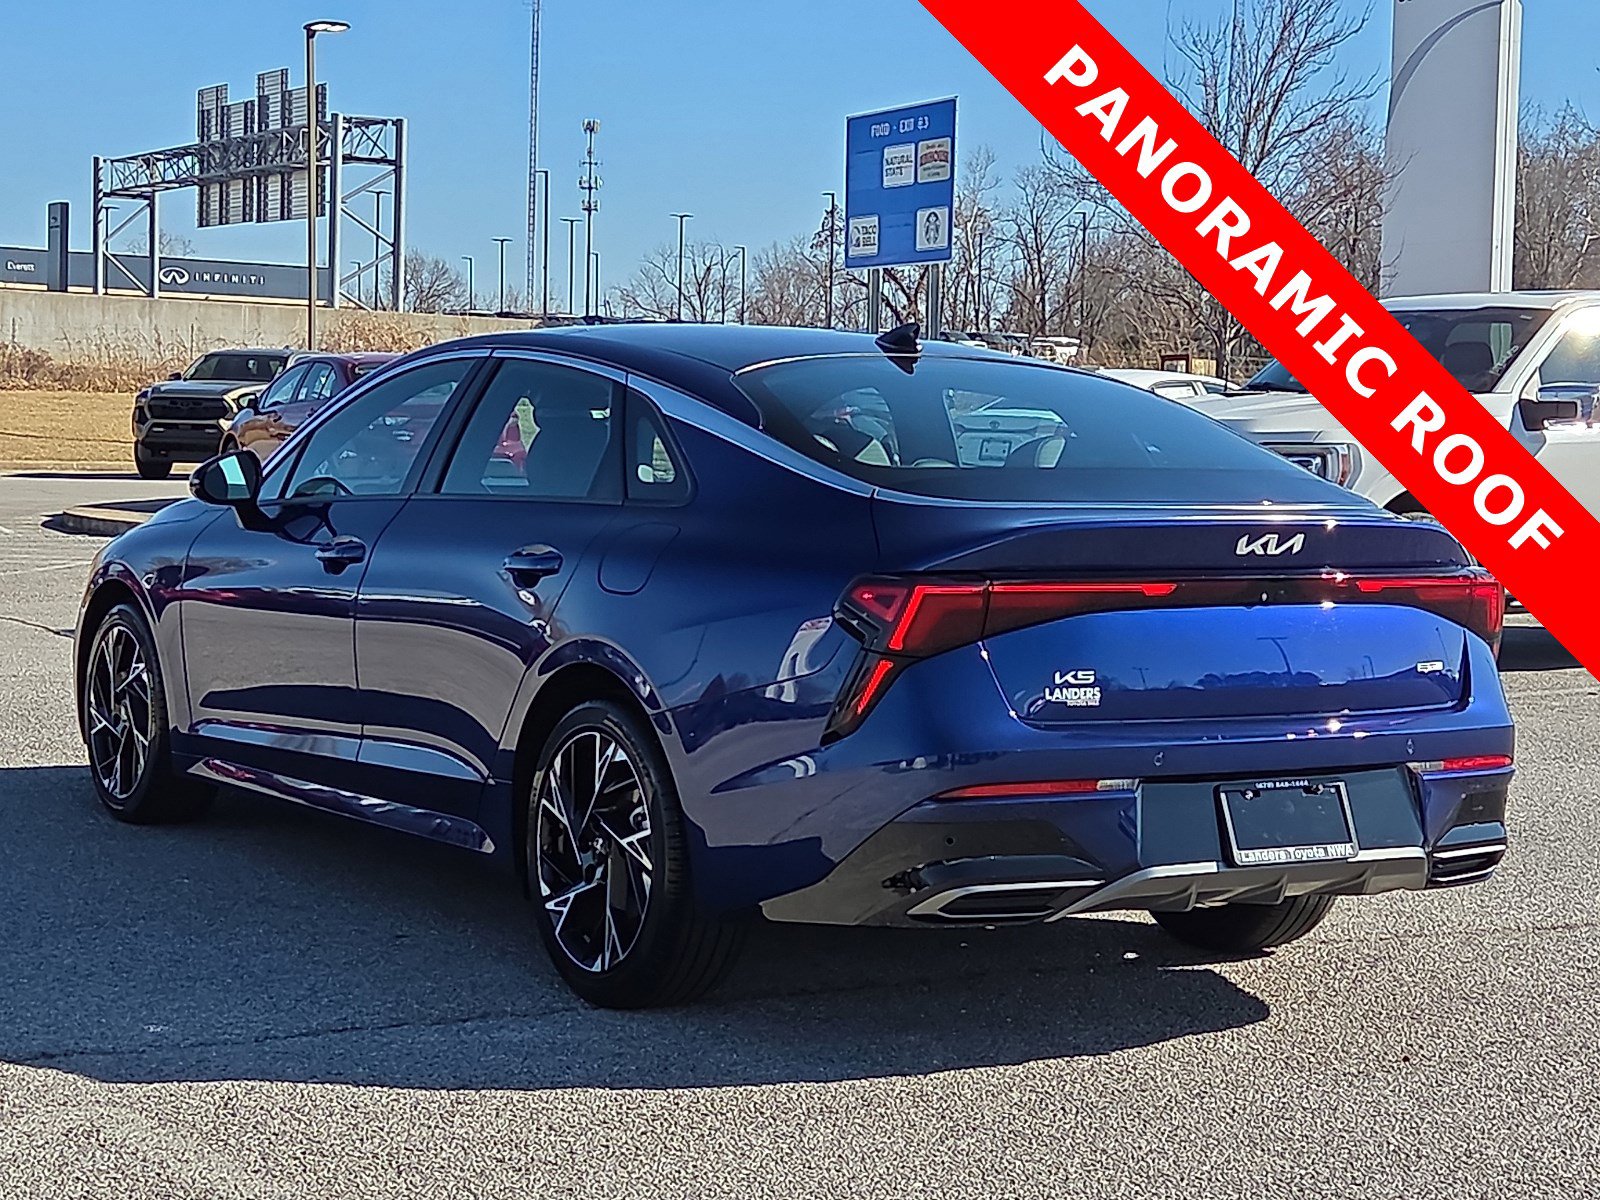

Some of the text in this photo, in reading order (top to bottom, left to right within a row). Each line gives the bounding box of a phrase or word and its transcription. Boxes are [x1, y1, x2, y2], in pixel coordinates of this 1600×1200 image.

[885, 167, 904, 177] STATE
[194, 272, 265, 285] INFINITI
[1236, 533, 1305, 555] KIA
[1054, 670, 1095, 684] K5
[1045, 687, 1101, 701] LANDERS
[1241, 844, 1354, 863] Landers Toyota NWA
